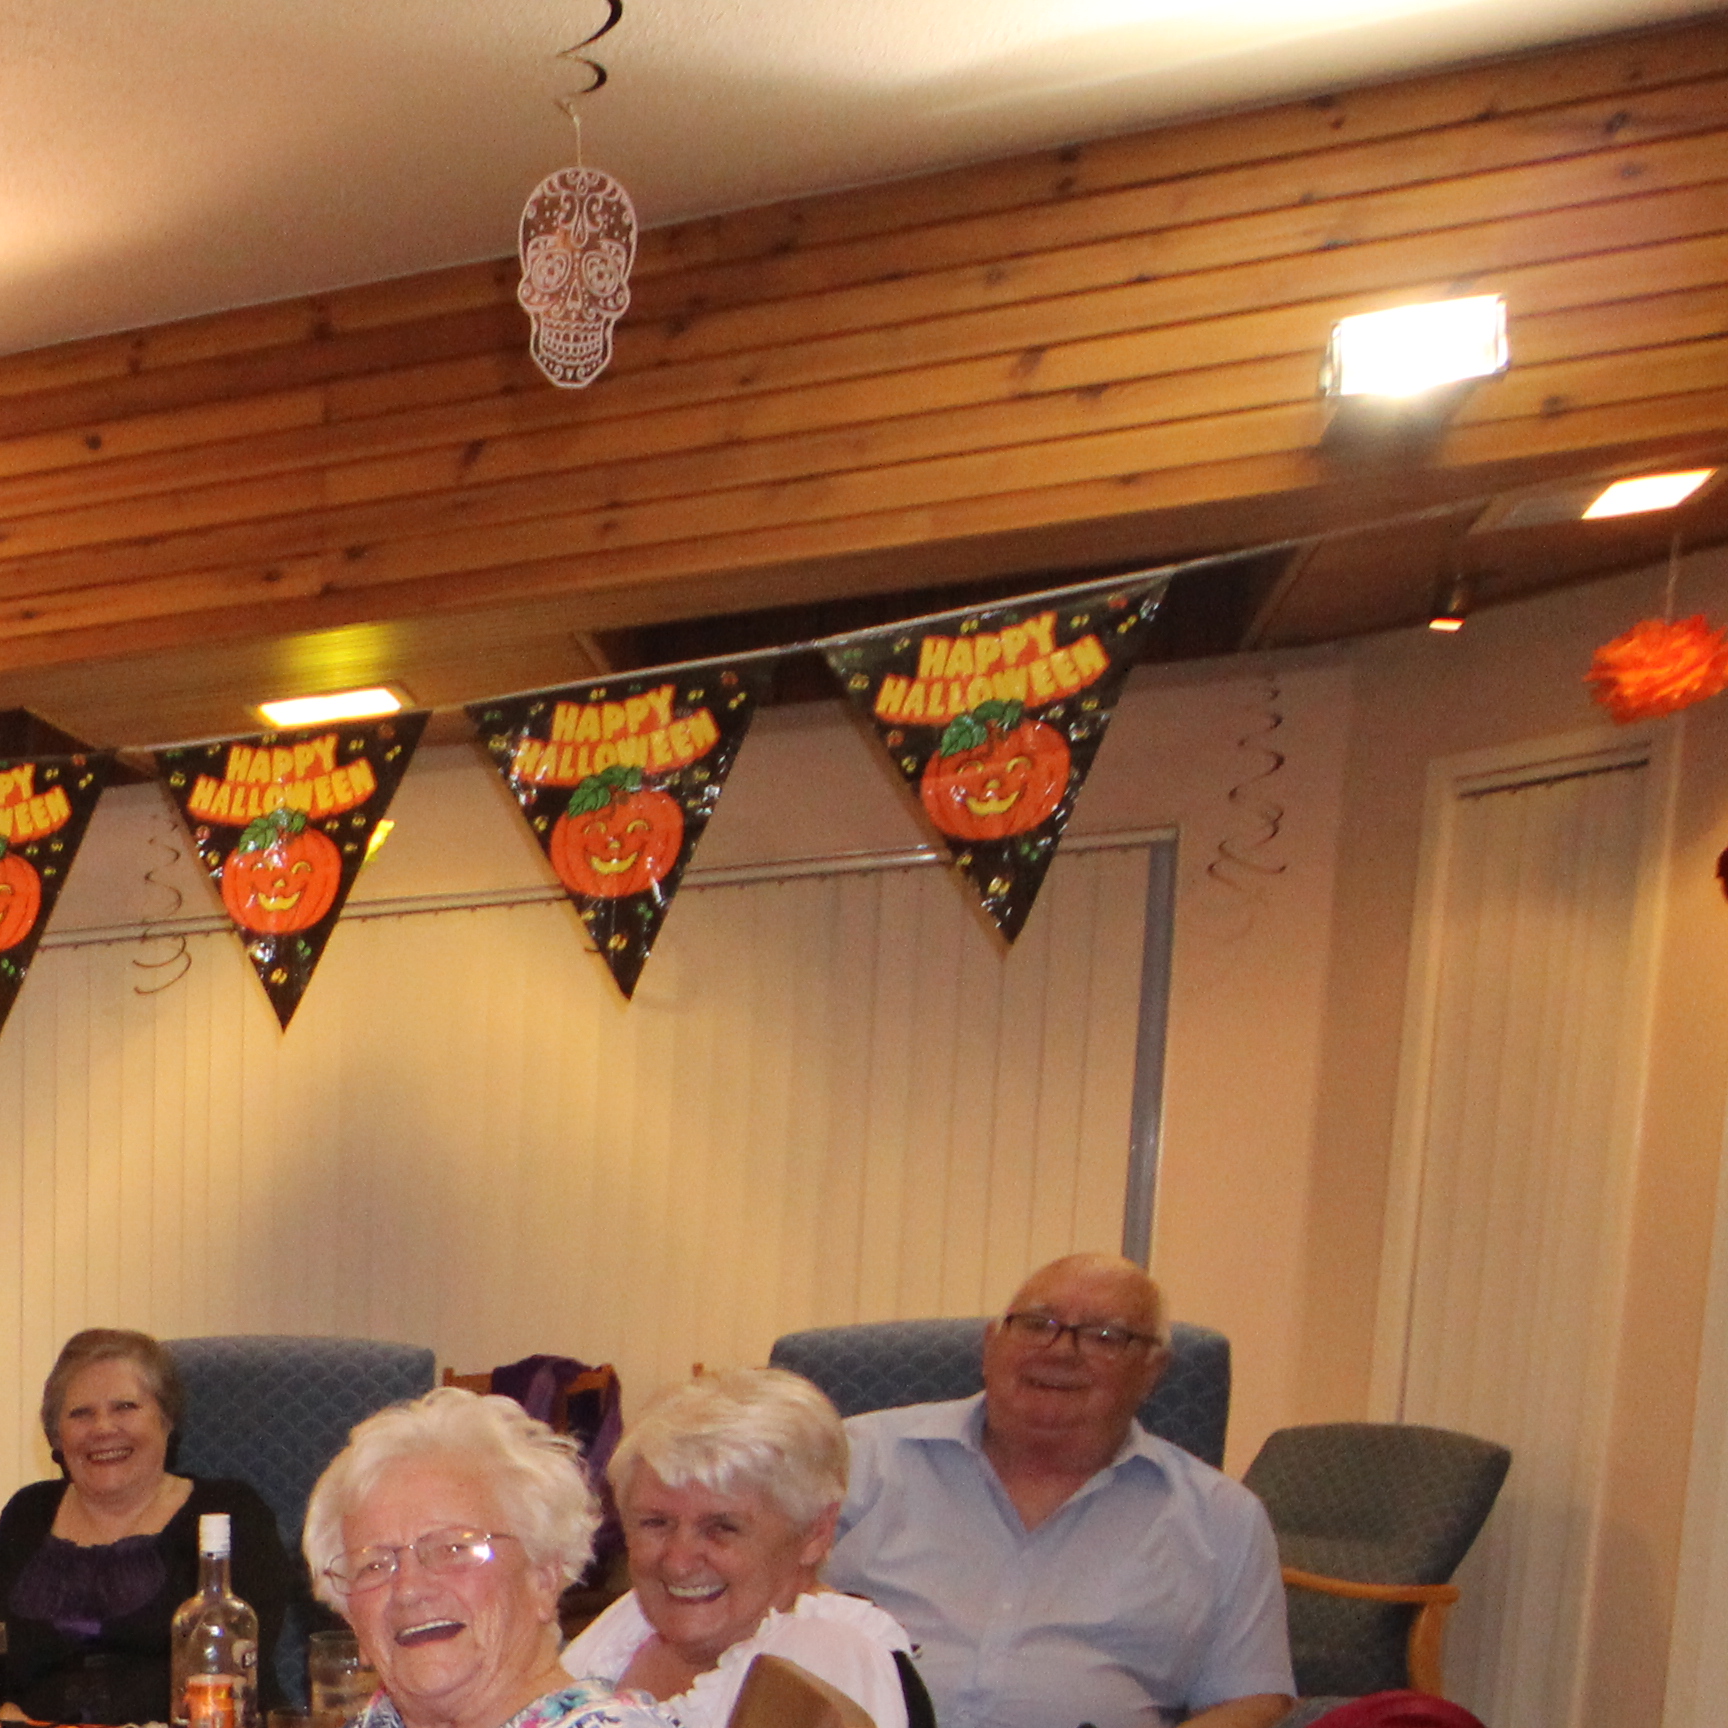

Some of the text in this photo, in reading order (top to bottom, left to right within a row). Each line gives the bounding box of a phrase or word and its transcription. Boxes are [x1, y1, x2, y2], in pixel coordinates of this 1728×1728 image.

[875, 635, 1109, 716] HALLOWEEN
[918, 611, 1057, 678] HAPPY
[514, 707, 720, 778] HALLOWEEN
[551, 685, 675, 741] HAPPY
[189, 758, 375, 817] HALLOWEEN
[226, 734, 338, 783] HAPPY
